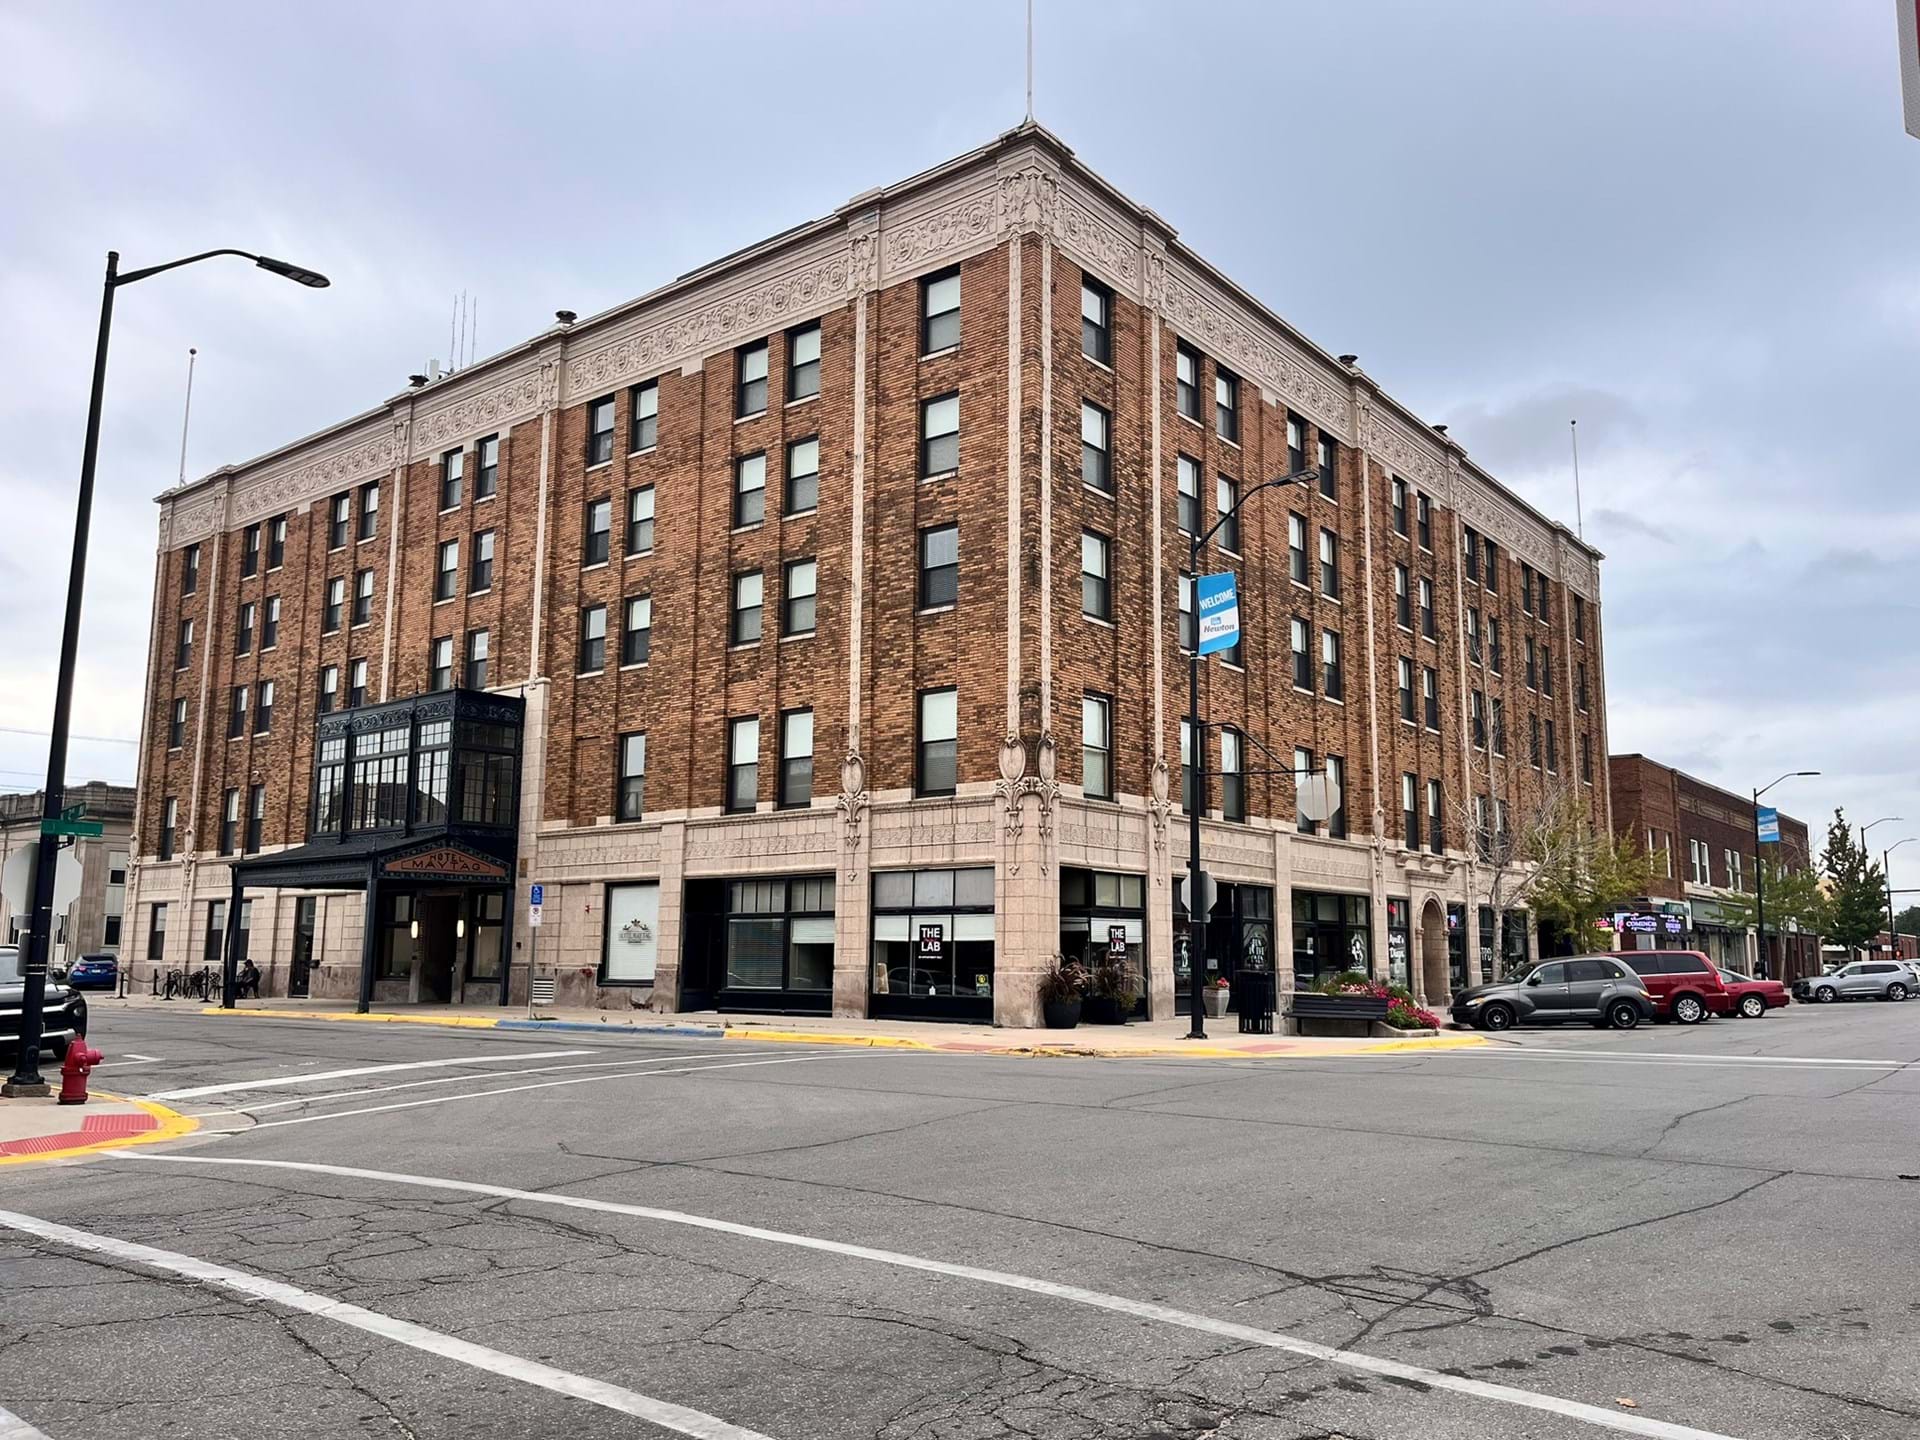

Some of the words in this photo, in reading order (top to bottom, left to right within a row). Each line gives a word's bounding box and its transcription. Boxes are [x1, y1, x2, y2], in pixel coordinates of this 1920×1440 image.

[1200, 588, 1235, 610] WELCOME
[1203, 624, 1235, 633] Newton
[430, 852, 465, 862] HOTEL
[412, 860, 481, 871] MAYTAG
[921, 927, 941, 938] THE
[1110, 928, 1125, 939] THE
[921, 941, 941, 952] LAB
[1110, 941, 1125, 952] LAB
